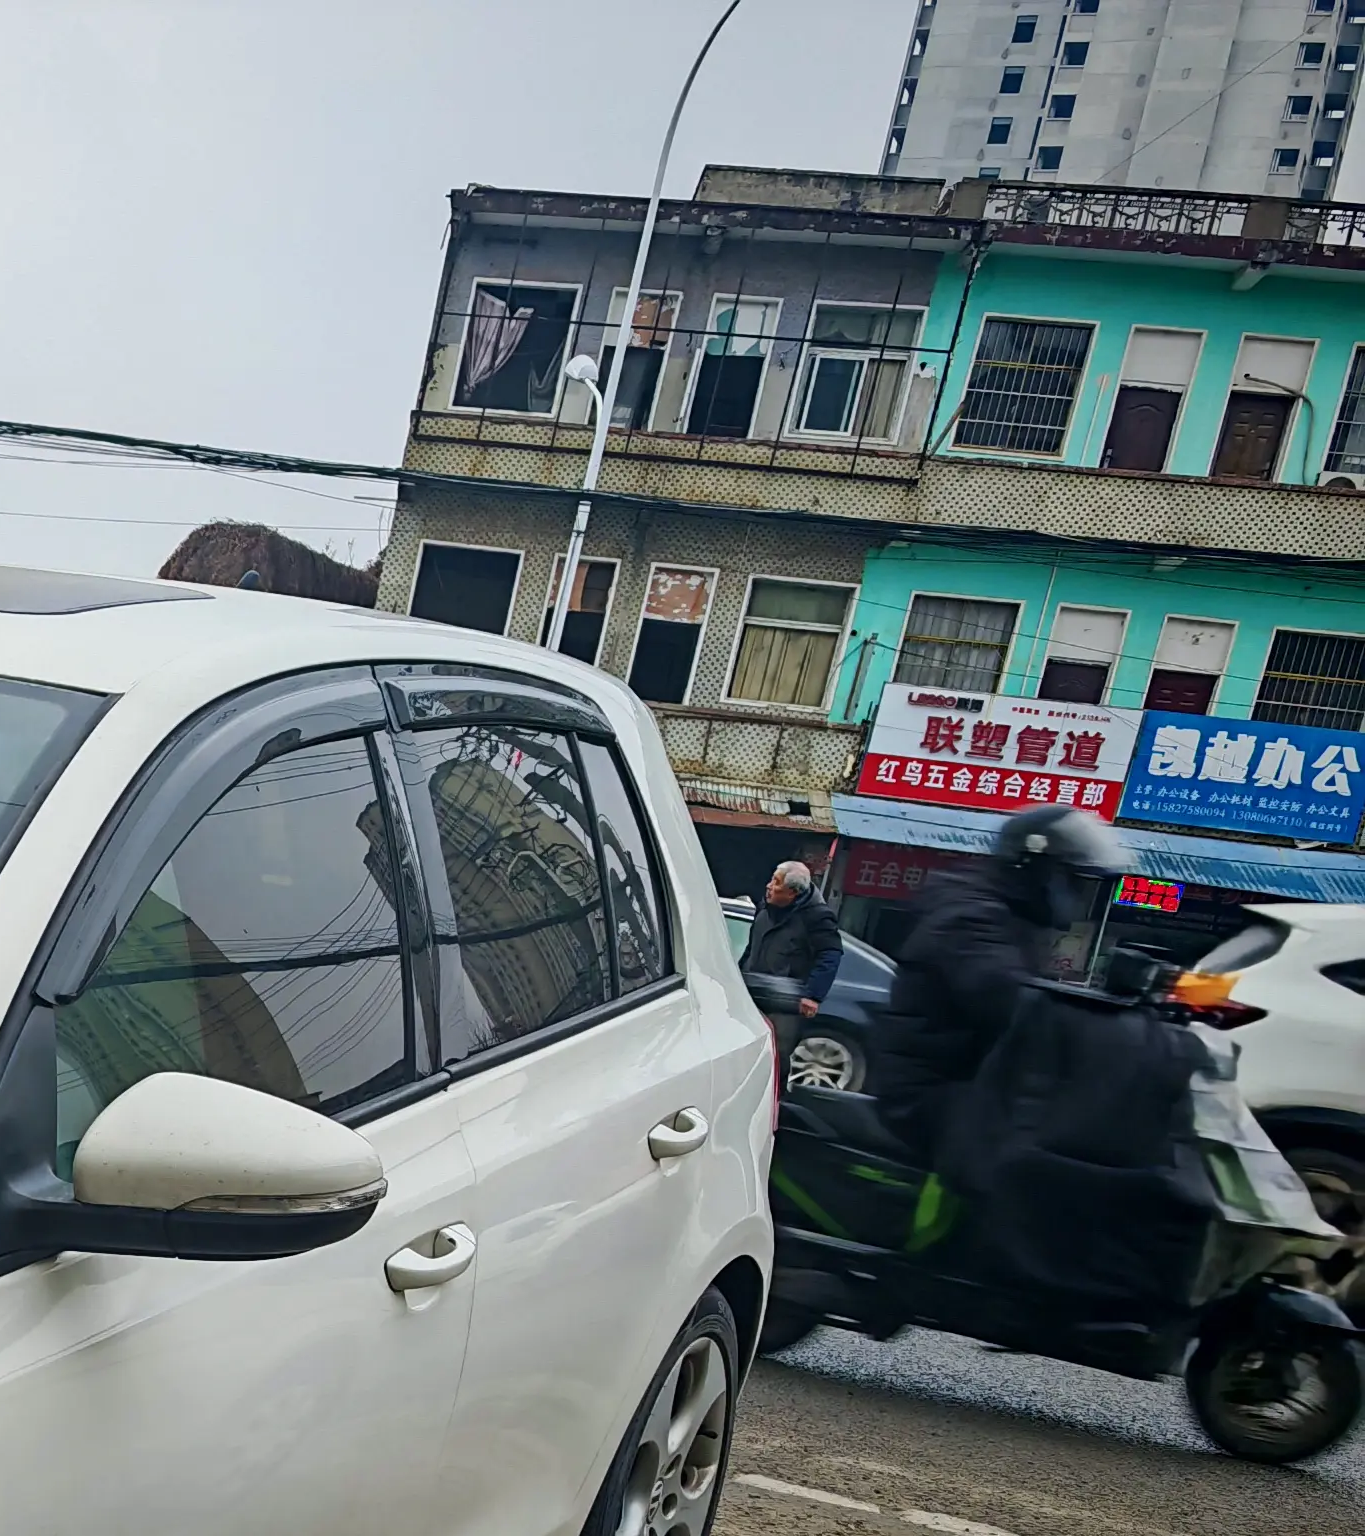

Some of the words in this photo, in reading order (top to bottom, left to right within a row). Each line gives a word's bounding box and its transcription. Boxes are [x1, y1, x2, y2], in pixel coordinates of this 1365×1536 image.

[920, 715, 1106, 772] 联塑管道
[876, 758, 1108, 807] 红鸟五金综合经营部
[855, 860, 927, 890] 五金电
